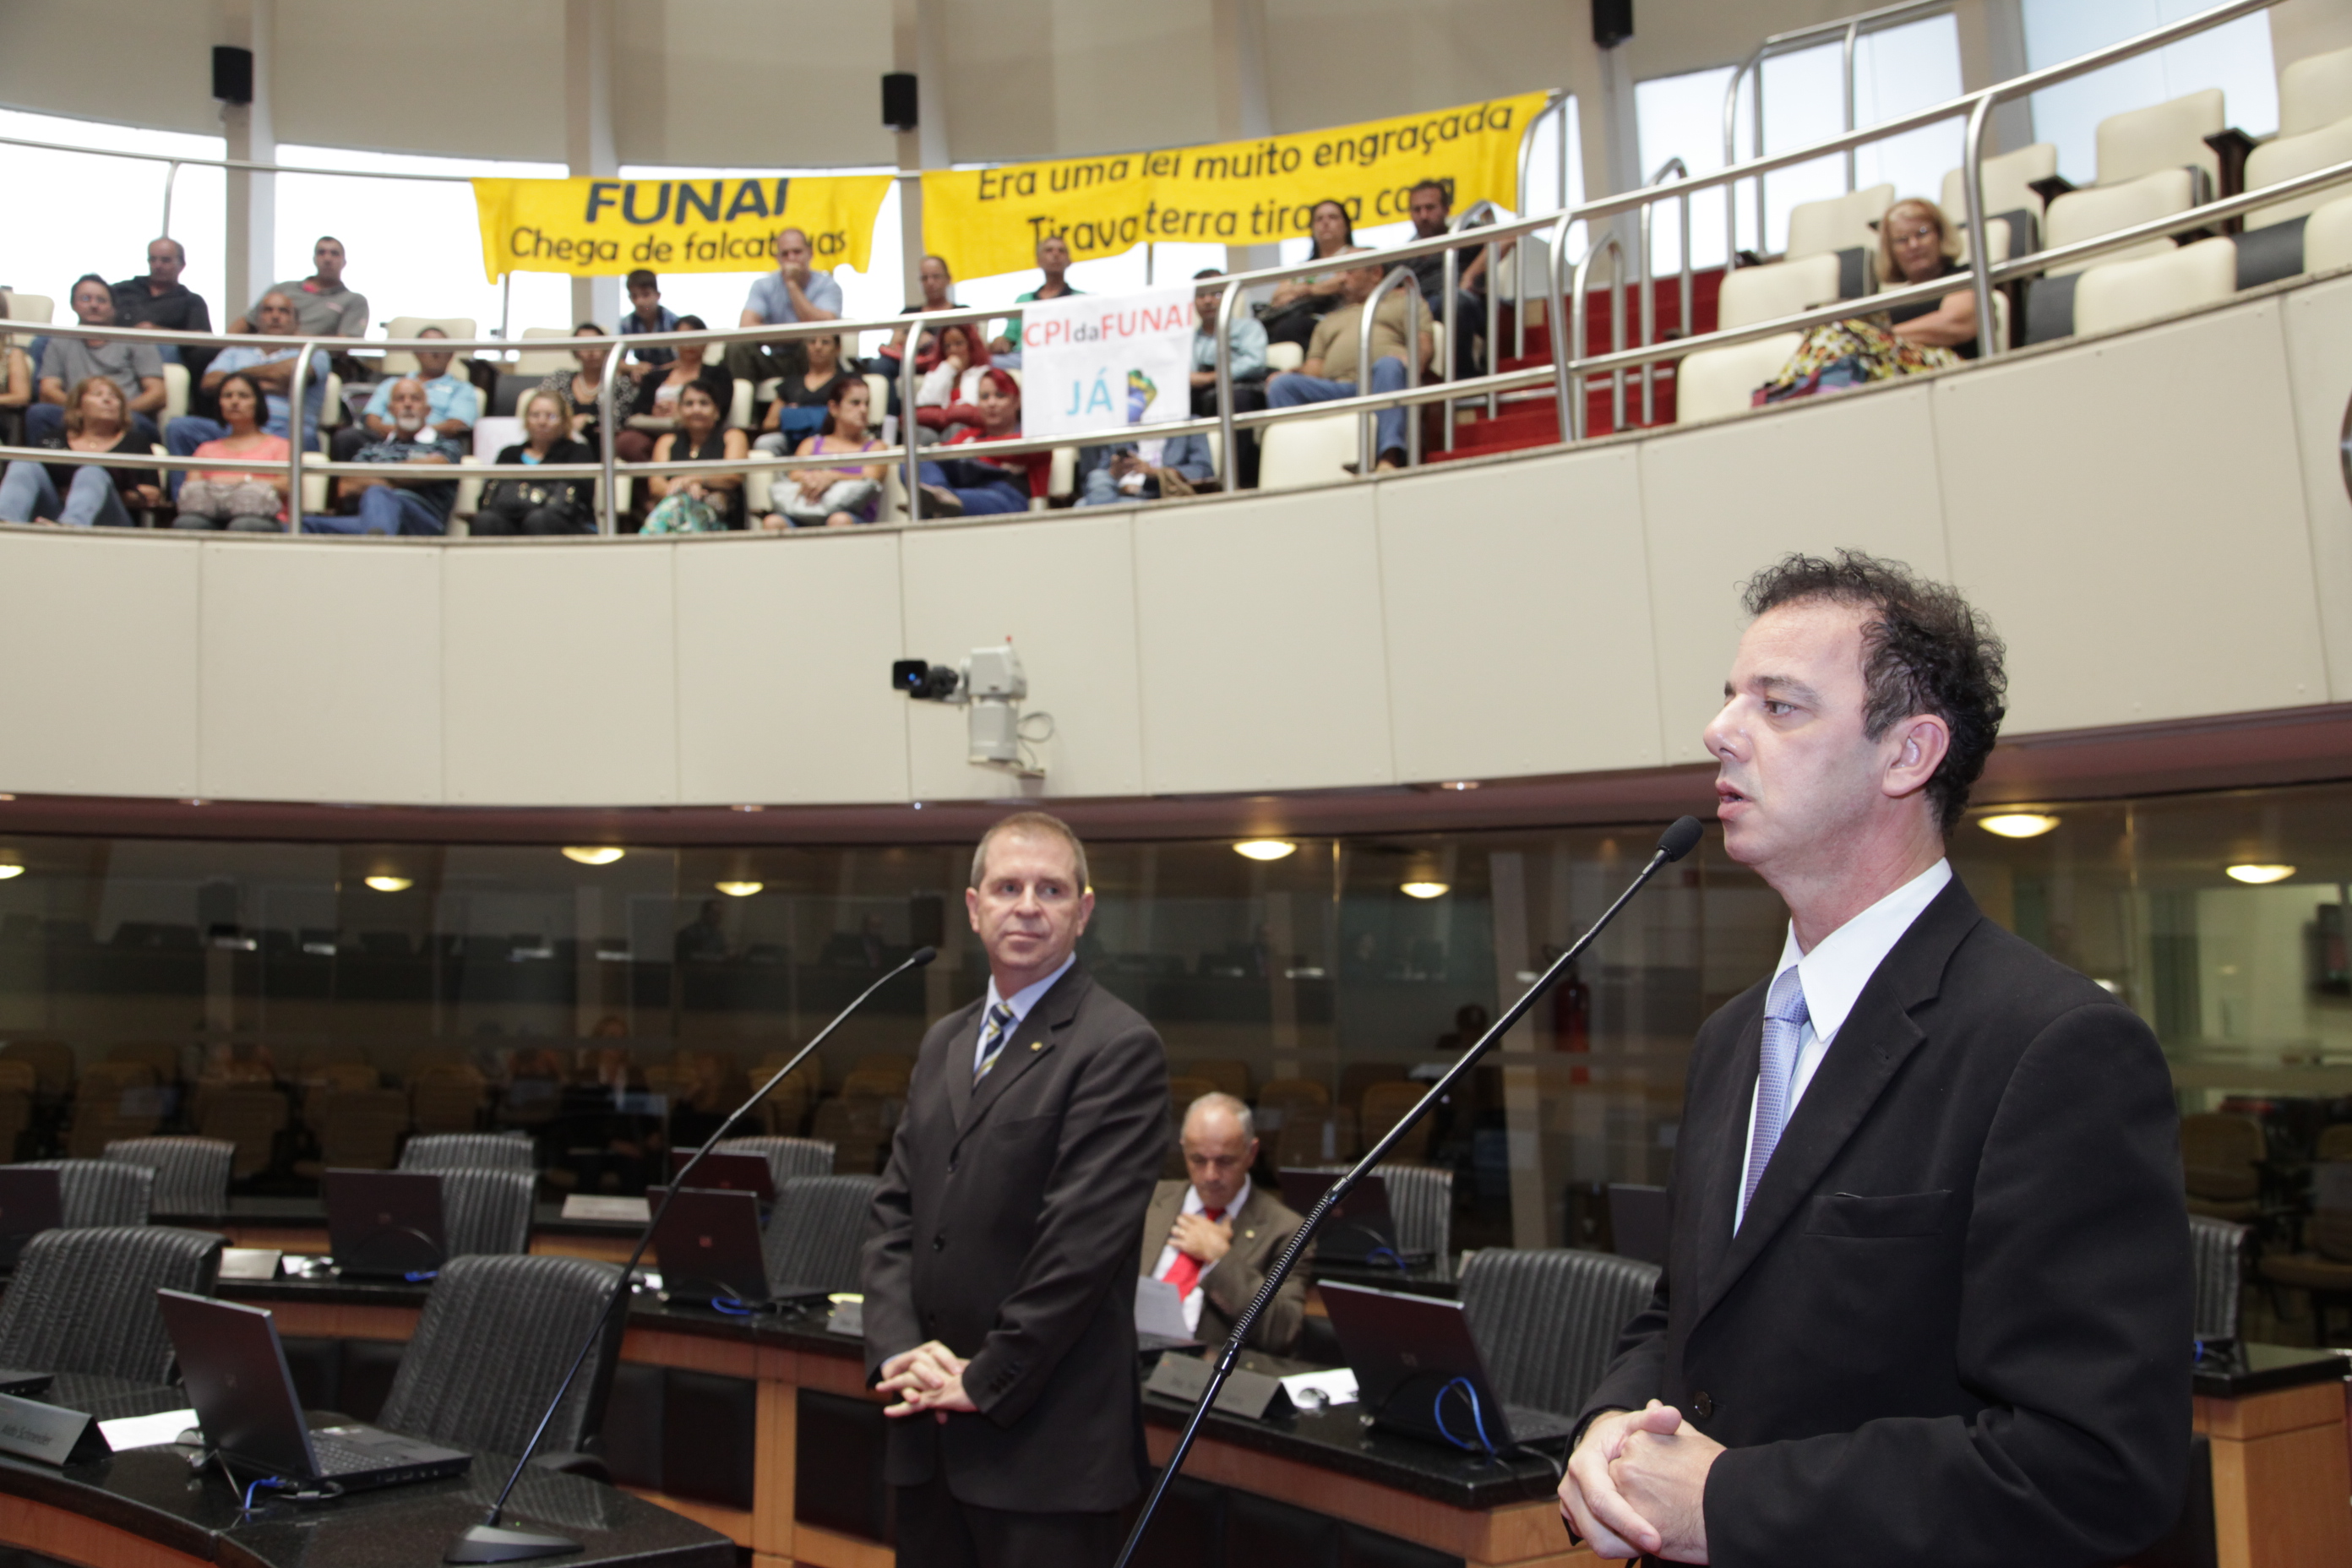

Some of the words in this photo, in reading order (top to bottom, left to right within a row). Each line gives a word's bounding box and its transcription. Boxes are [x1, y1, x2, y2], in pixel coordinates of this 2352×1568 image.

[978, 168, 1037, 201] Era
[1050, 158, 1130, 192] uma
[1142, 152, 1181, 177] lei
[1194, 141, 1302, 180] muito
[1314, 103, 1513, 166] engraçada
[585, 178, 790, 225] FUNAI
[1144, 200, 1238, 237] terra
[1251, 196, 1363, 236] tiraa
[510, 226, 619, 267] Chega
[632, 233, 673, 263] de
[684, 230, 847, 262] falcatas
[1065, 367, 1114, 416] JÁ
